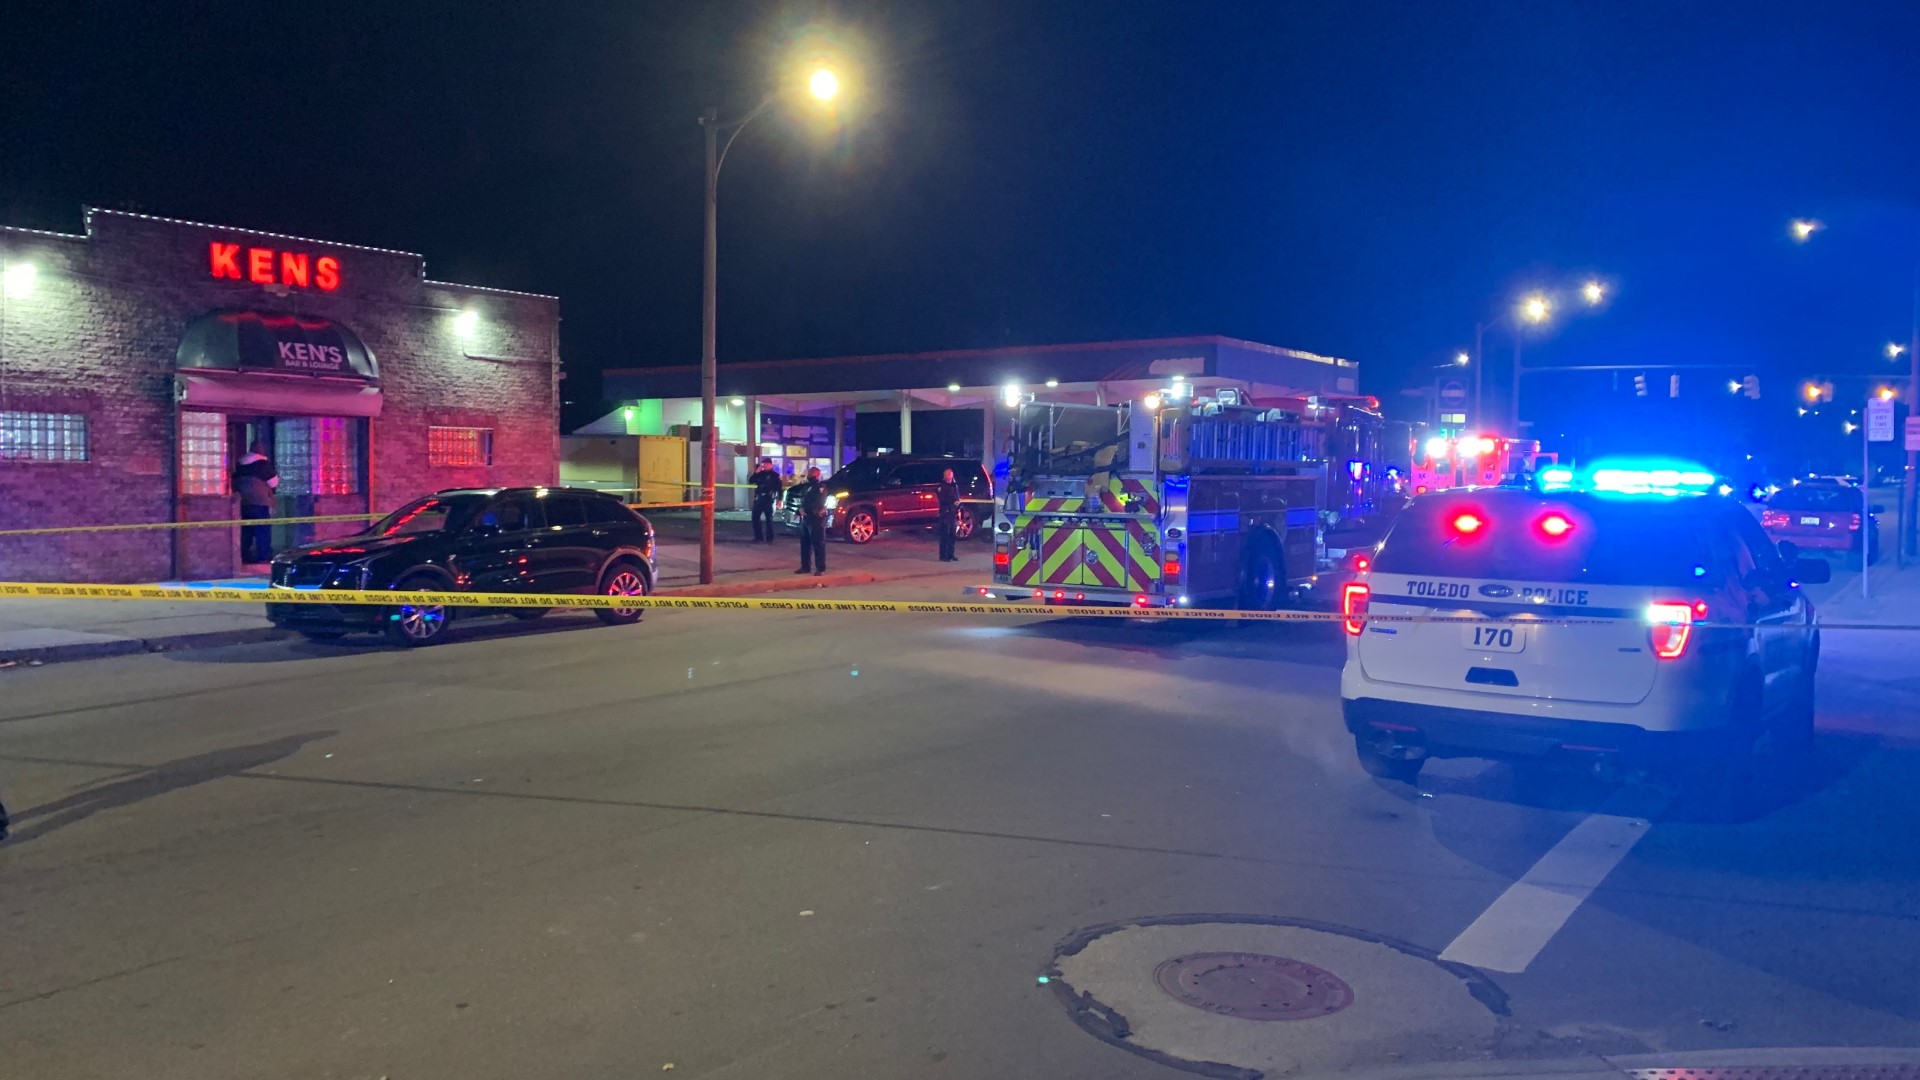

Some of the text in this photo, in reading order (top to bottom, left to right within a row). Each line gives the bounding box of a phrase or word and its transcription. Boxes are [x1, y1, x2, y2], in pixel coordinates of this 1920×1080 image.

[209, 241, 340, 291] KENS
[278, 341, 343, 363] KEN'S
[1407, 581, 1589, 606] TOLEDO POLICE
[1473, 627, 1513, 648] 170
